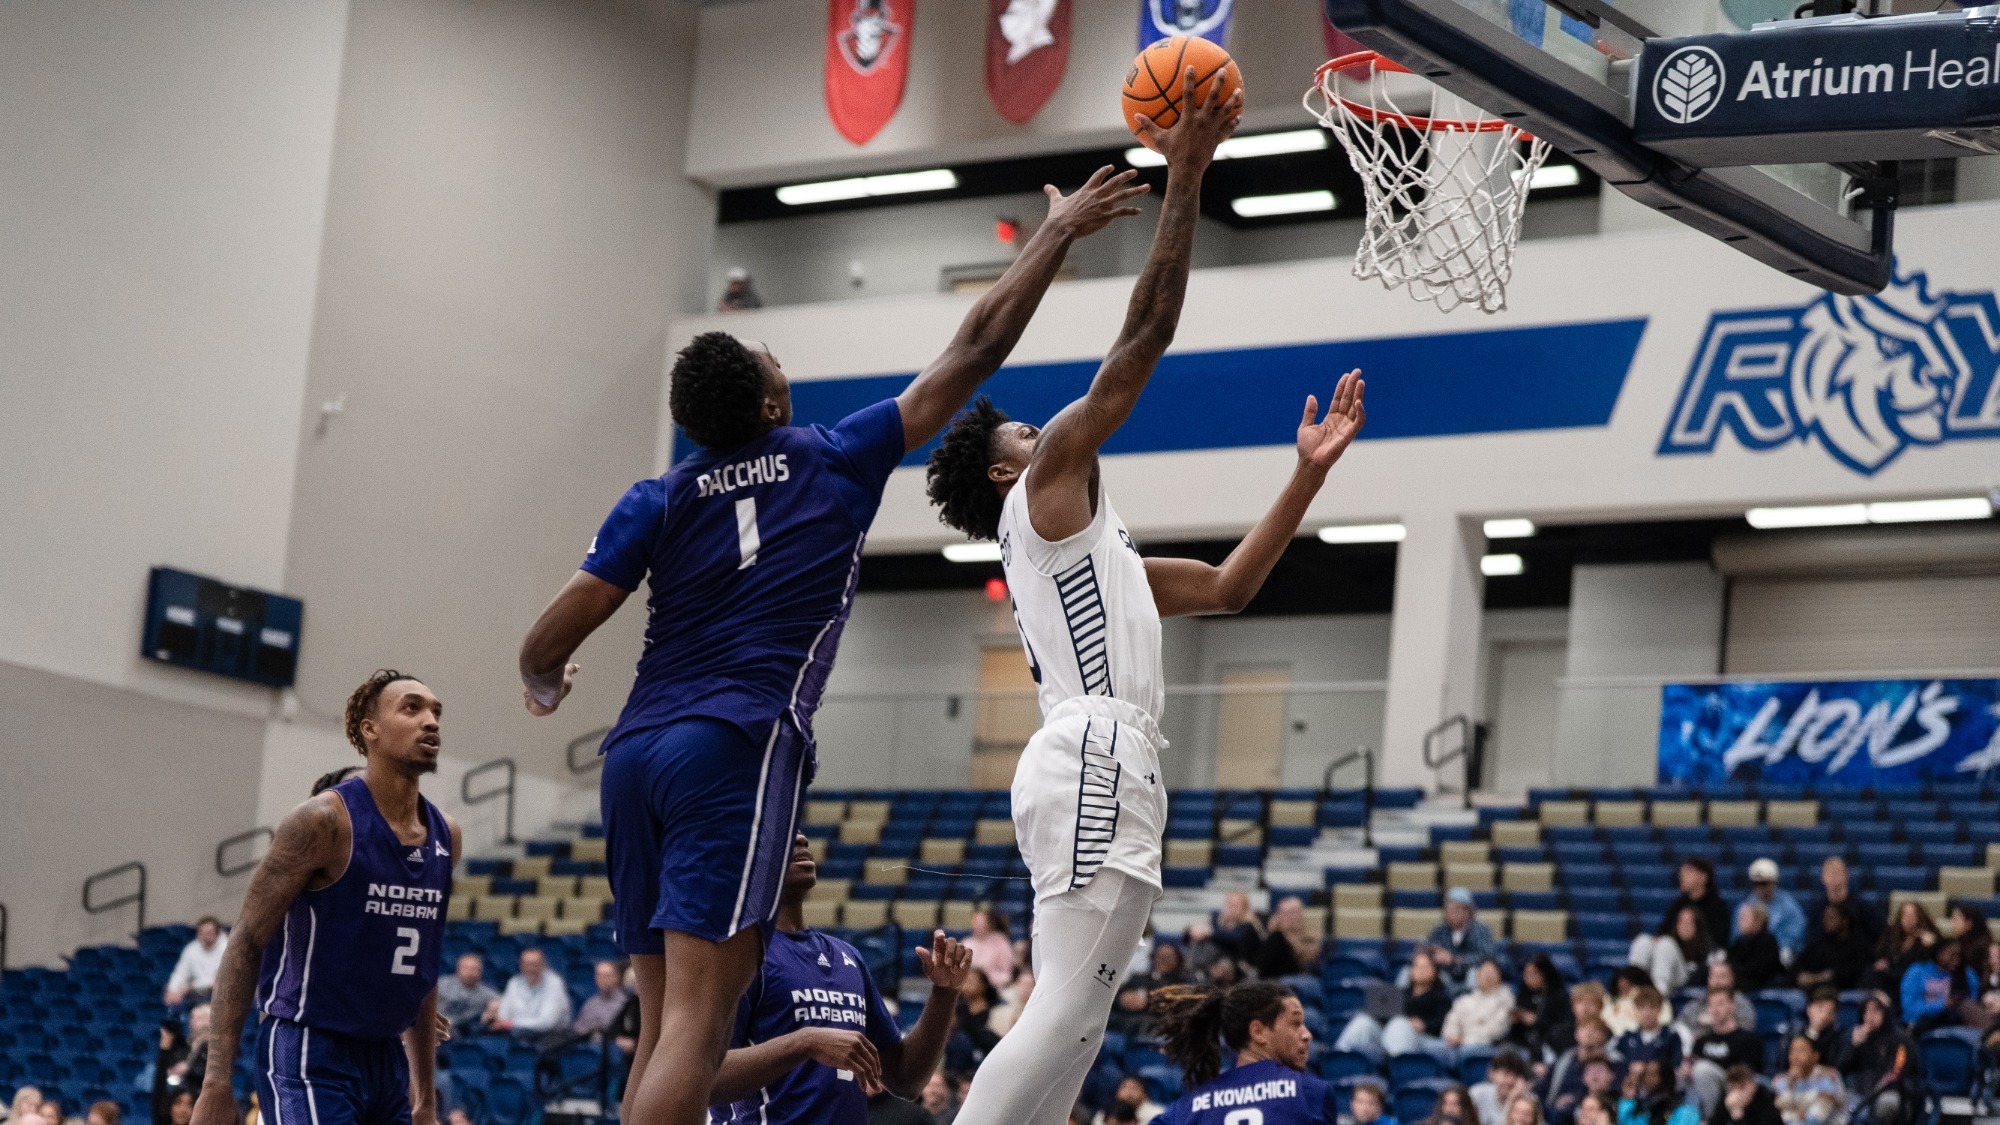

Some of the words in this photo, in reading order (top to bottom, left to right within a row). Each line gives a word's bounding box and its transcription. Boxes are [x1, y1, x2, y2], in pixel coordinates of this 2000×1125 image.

[1736, 57, 1894, 101] Atrium
[1903, 43, 2000, 91] Heal
[735, 497, 761, 570] 1
[1723, 681, 1959, 776] LION'S
[391, 927, 420, 975] 2
[791, 988, 866, 1011] NORTH
[1191, 1092, 1211, 1113] DE
[1213, 1079, 1297, 1107] KOVACHICH
